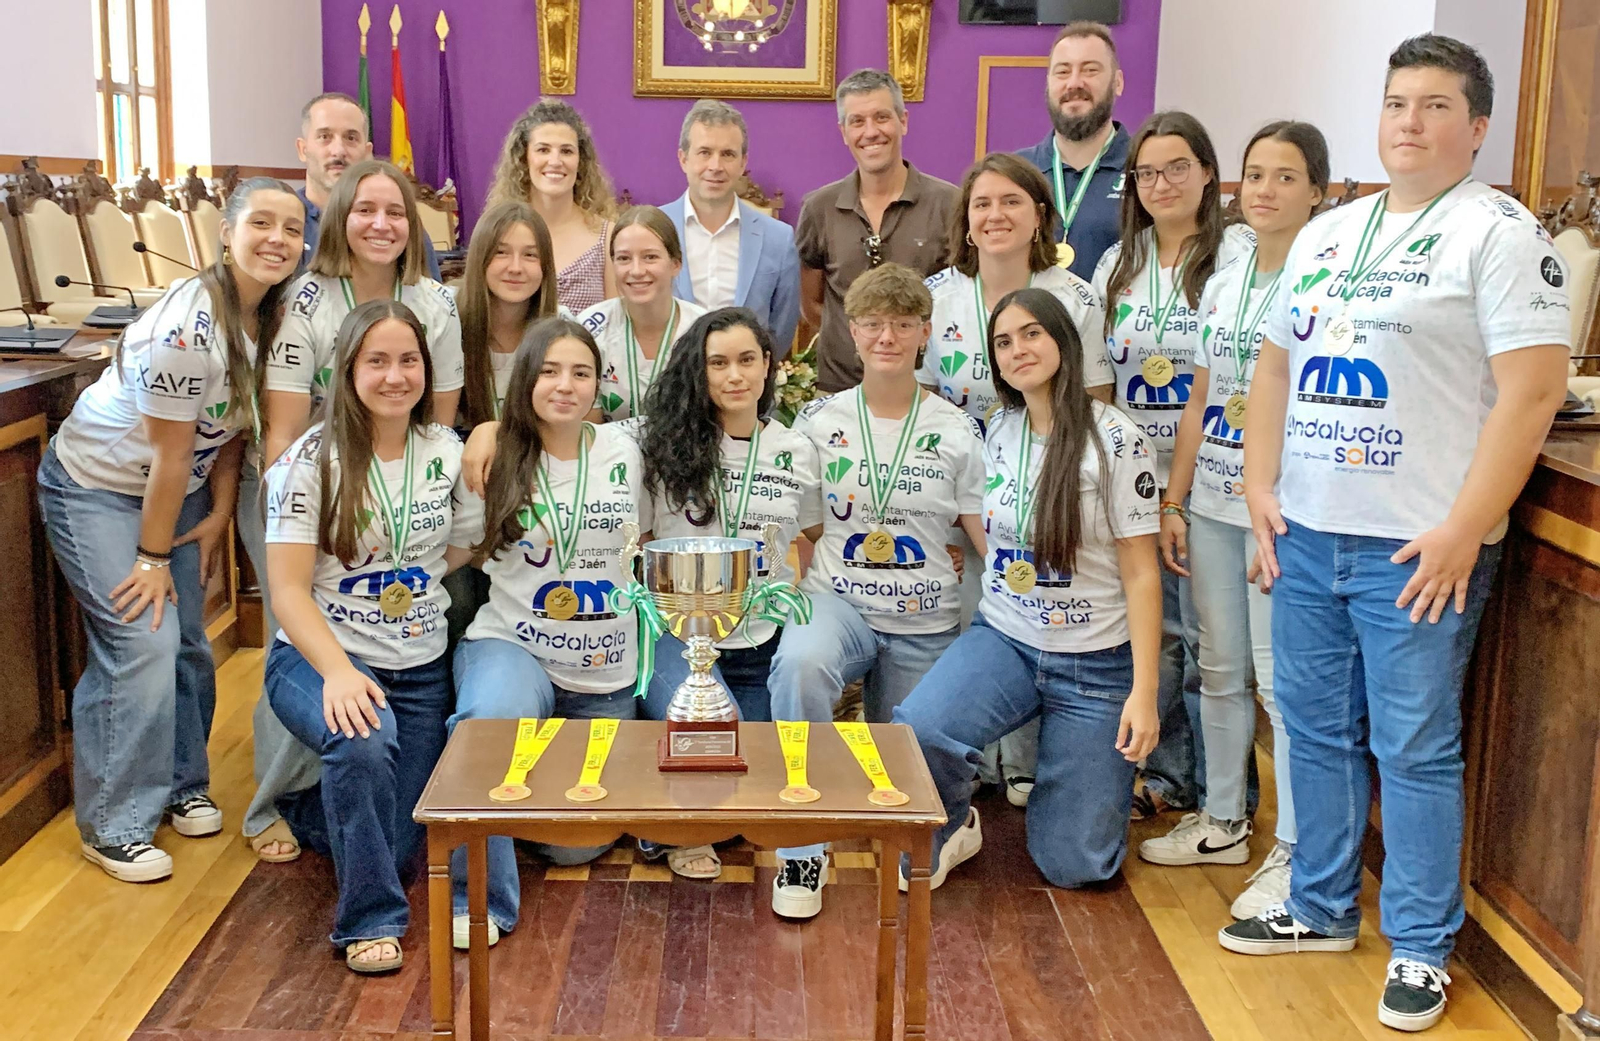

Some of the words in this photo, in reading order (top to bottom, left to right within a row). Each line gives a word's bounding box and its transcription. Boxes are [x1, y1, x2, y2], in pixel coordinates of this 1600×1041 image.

[1297, 394, 1383, 408] AMSYSTEM
[1334, 444, 1403, 466] solar
[861, 503, 937, 518] Ayntamiento
[861, 515, 876, 524] de
[879, 516, 906, 525] Jaén
[579, 559, 607, 569] Jaén
[896, 595, 942, 613] solar
[1040, 610, 1094, 625] solar
[581, 649, 626, 668] solar
